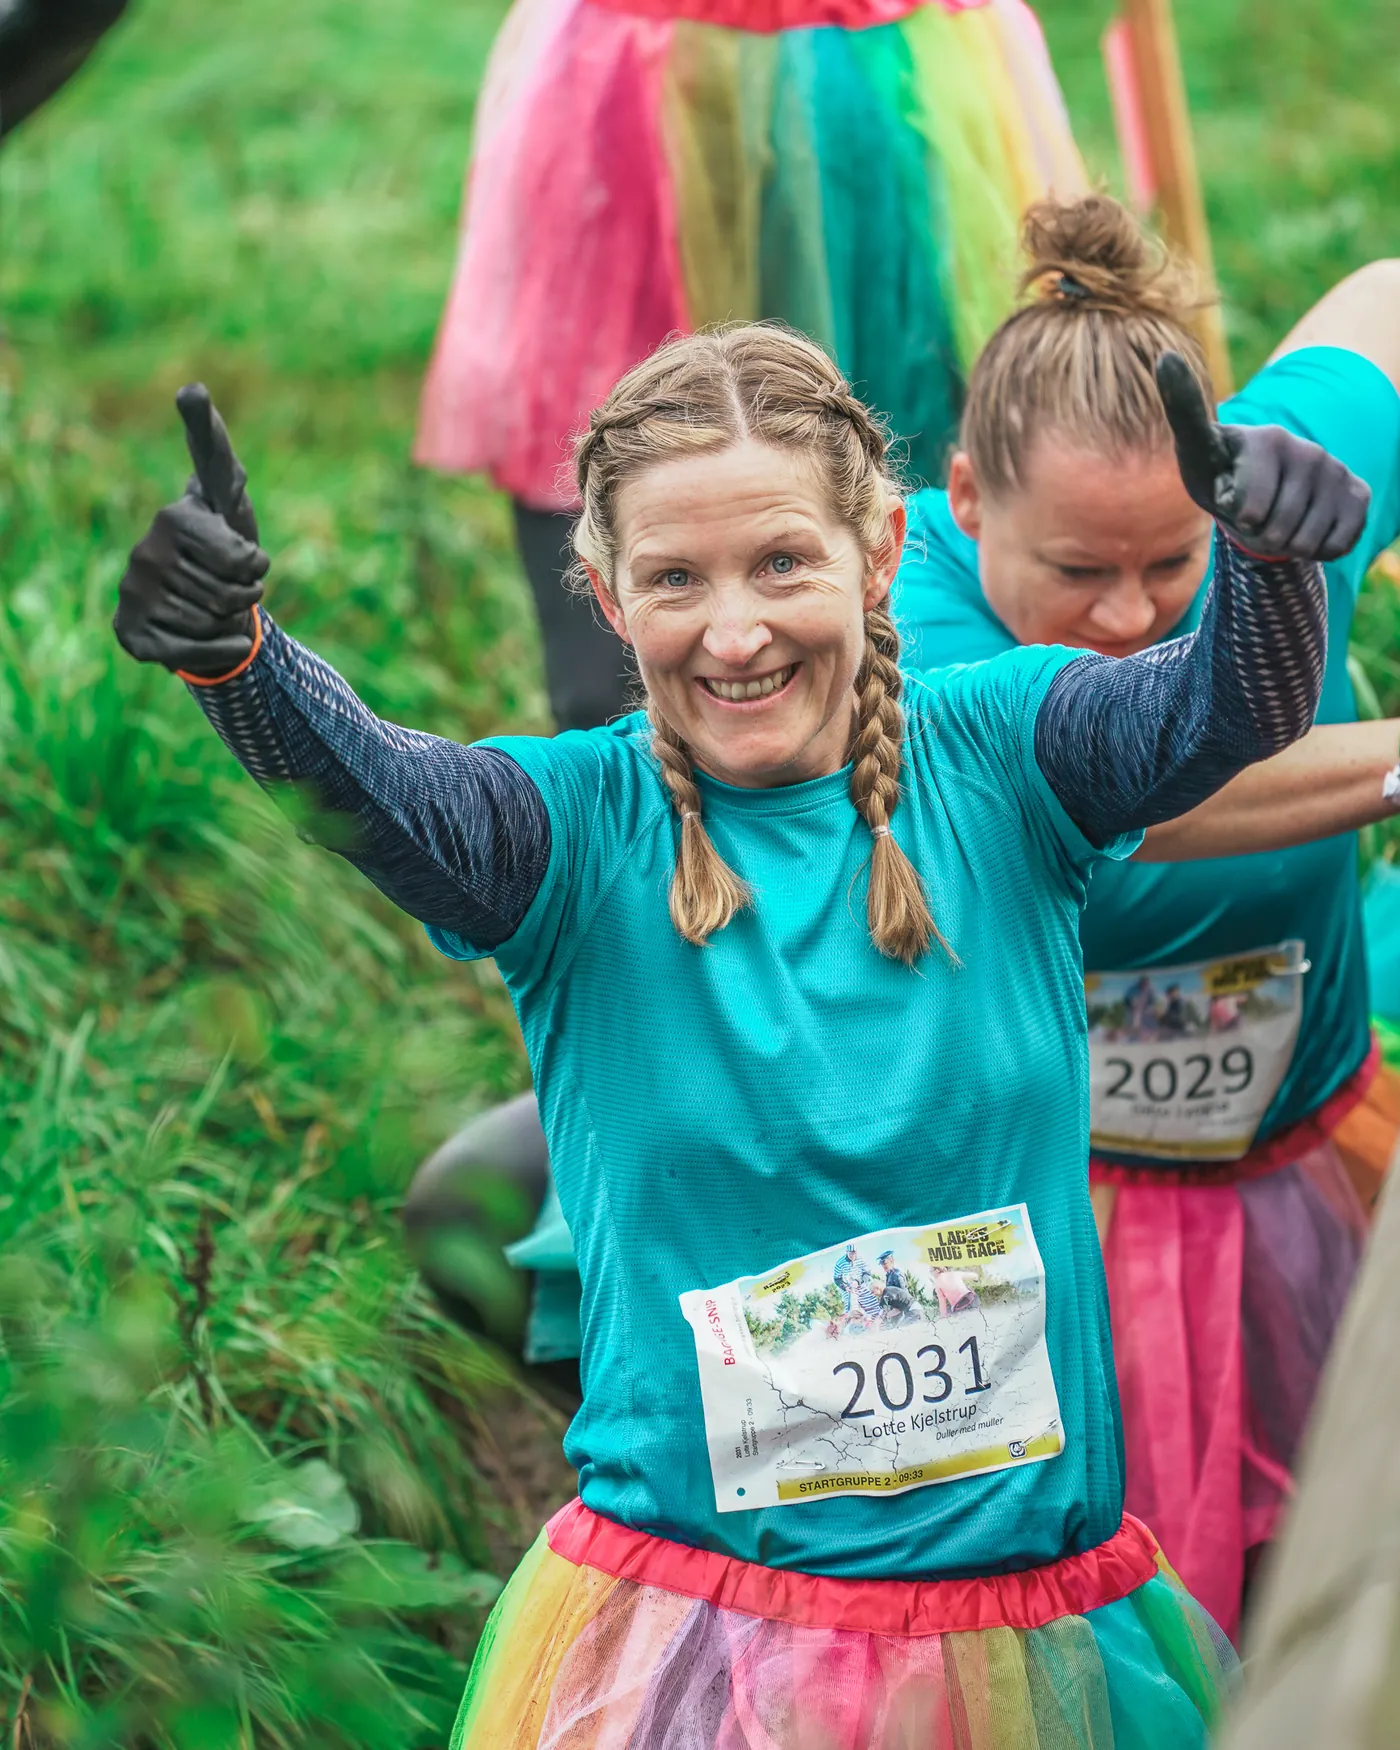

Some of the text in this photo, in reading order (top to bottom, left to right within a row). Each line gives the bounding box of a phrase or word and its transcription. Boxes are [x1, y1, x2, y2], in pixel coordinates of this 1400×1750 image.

[1104, 1045, 1254, 1103] 2029
[937, 1227, 990, 1246] LADES
[928, 1239, 1006, 1262] MUD RACE
[833, 1335, 991, 1419] 2031
[862, 1403, 977, 1439] Lotte Kjelstrup
[936, 1417, 1004, 1441] Duller med muller
[799, 1476, 882, 1493] STARTGRUPPE
[884, 1477, 891, 1486] 2
[898, 1469, 923, 1483] 09:33
